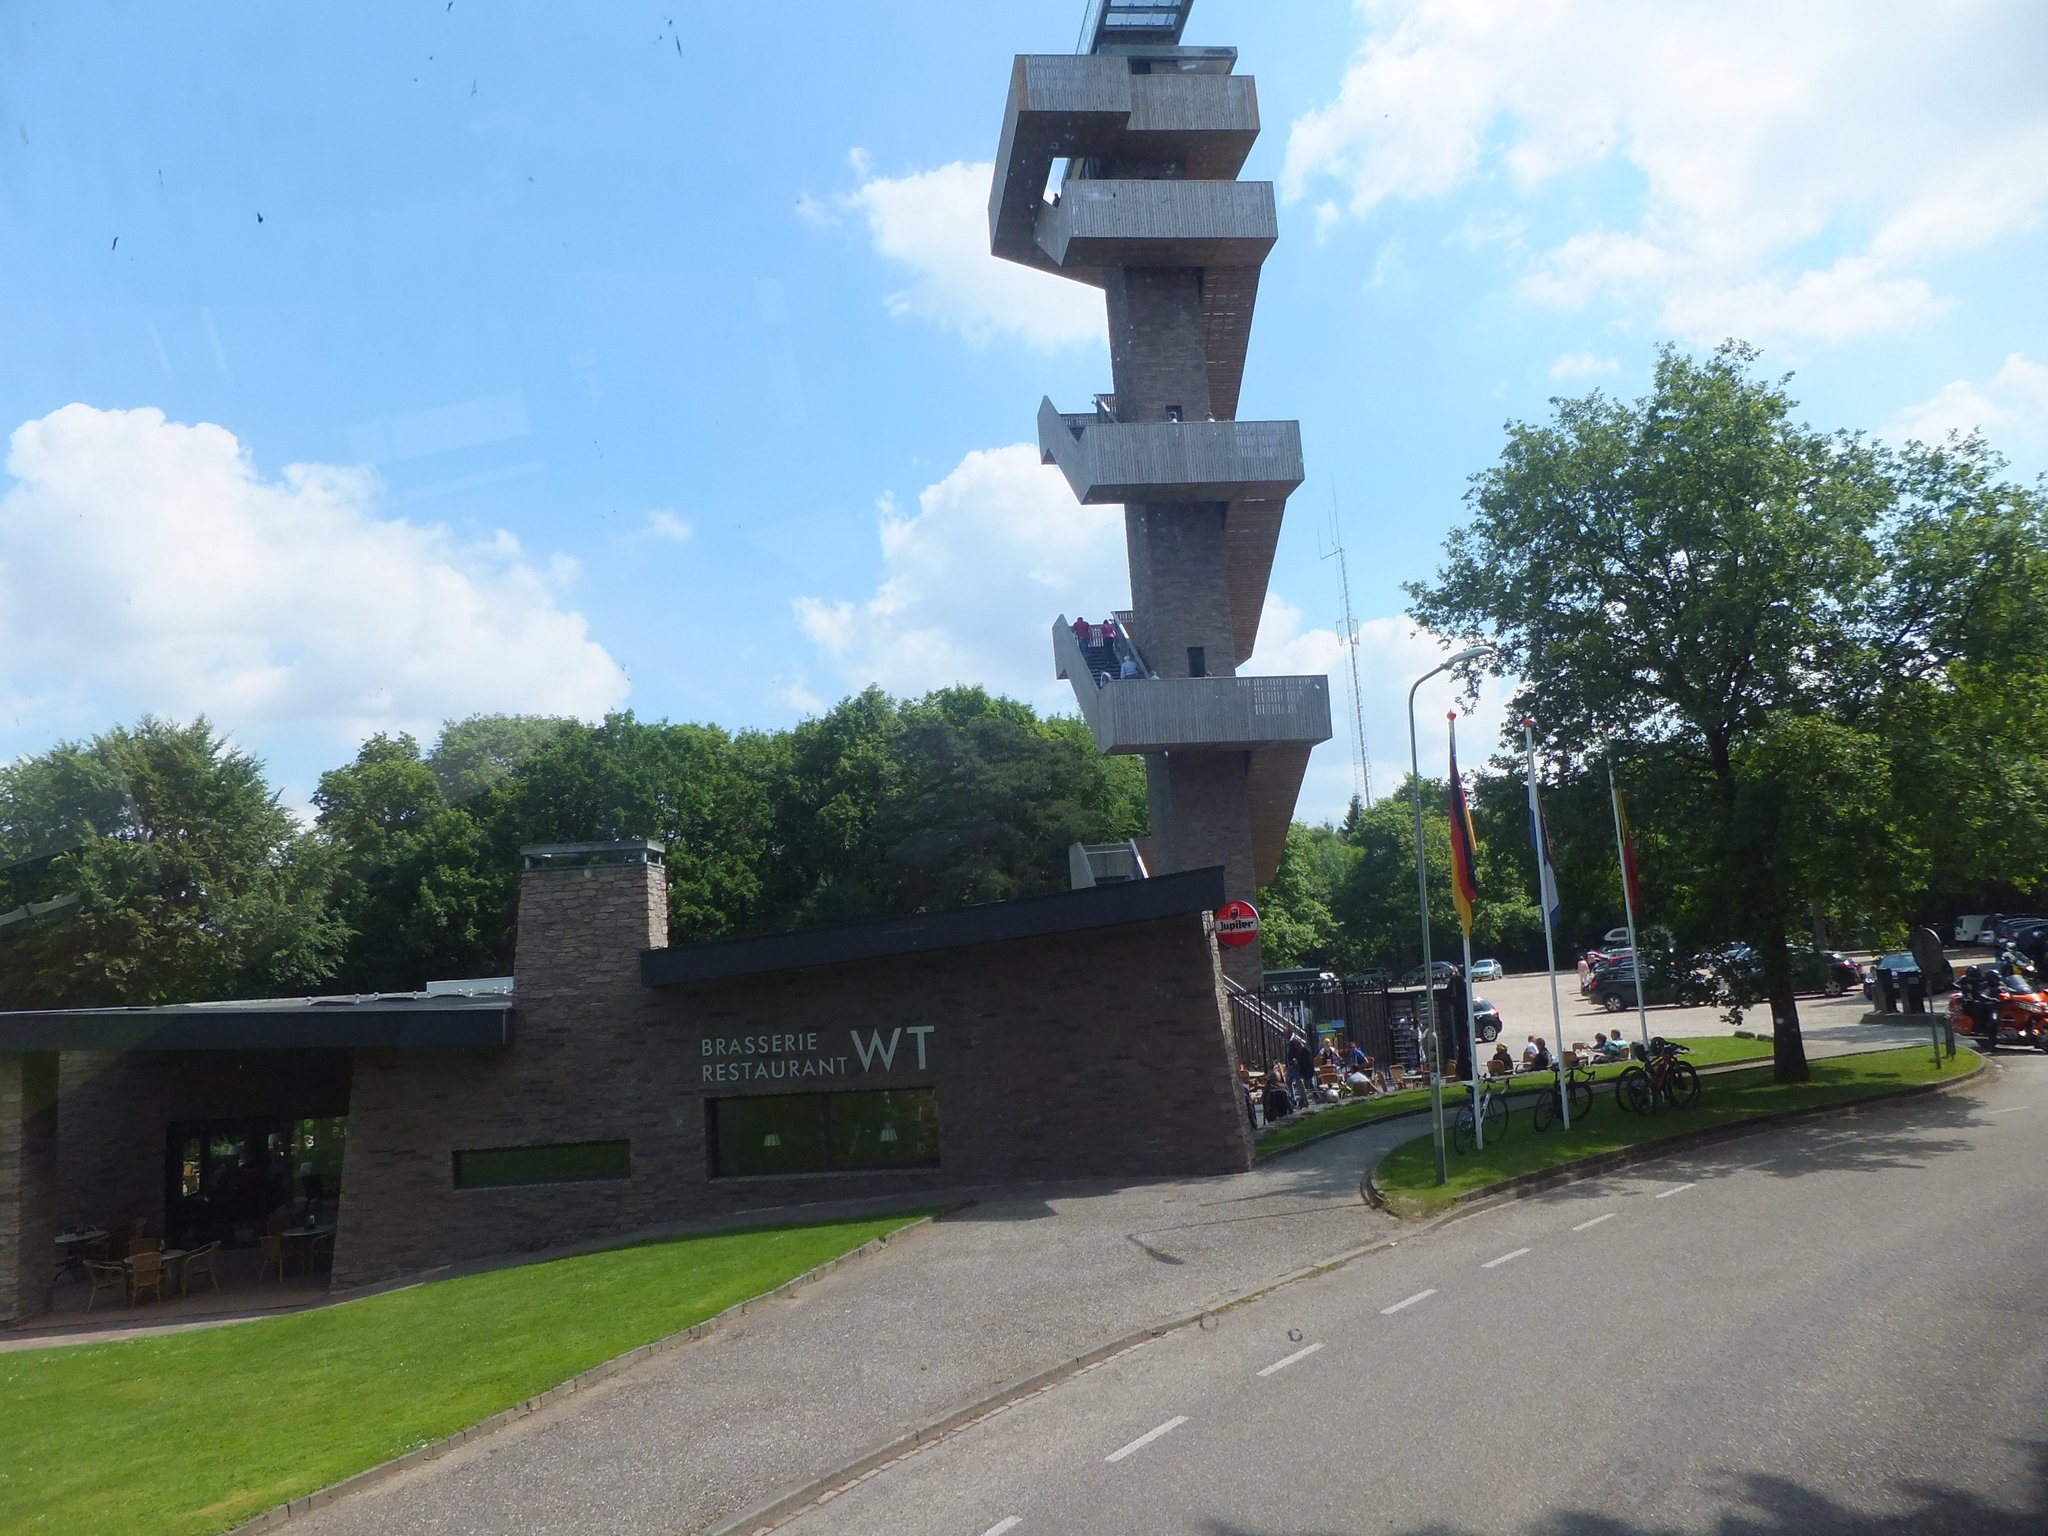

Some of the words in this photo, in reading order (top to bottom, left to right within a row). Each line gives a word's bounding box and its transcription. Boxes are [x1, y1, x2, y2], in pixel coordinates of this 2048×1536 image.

[1219, 920, 1254, 932] Jupiler
[701, 1033, 818, 1056] BRASSERIE
[850, 1025, 935, 1073] WT
[702, 1057, 848, 1082] RESTAURANT
